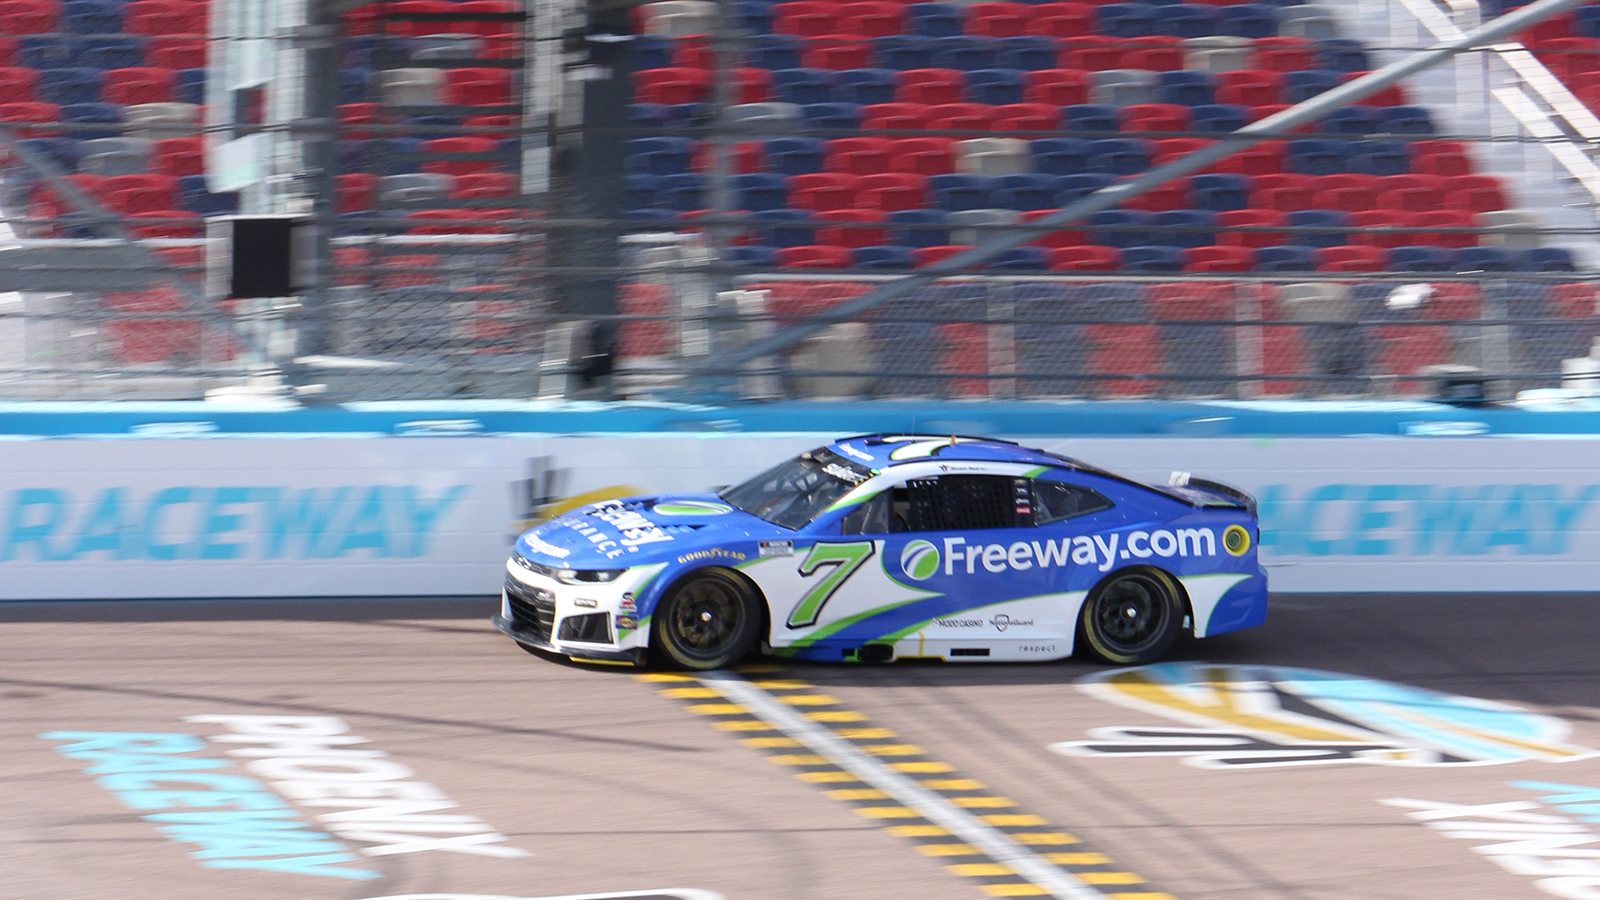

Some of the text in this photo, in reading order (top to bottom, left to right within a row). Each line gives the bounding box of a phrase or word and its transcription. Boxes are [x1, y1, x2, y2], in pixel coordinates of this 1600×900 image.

[0, 485, 474, 560] RACEWAY
[677, 547, 746, 564] GOODYEAR
[943, 527, 1216, 575] Freeway.com
[1256, 483, 1600, 555] ACEWAY
[787, 540, 875, 629] 7
[38, 731, 384, 879] RACEWAY
[185, 714, 532, 857] PHOENIX
